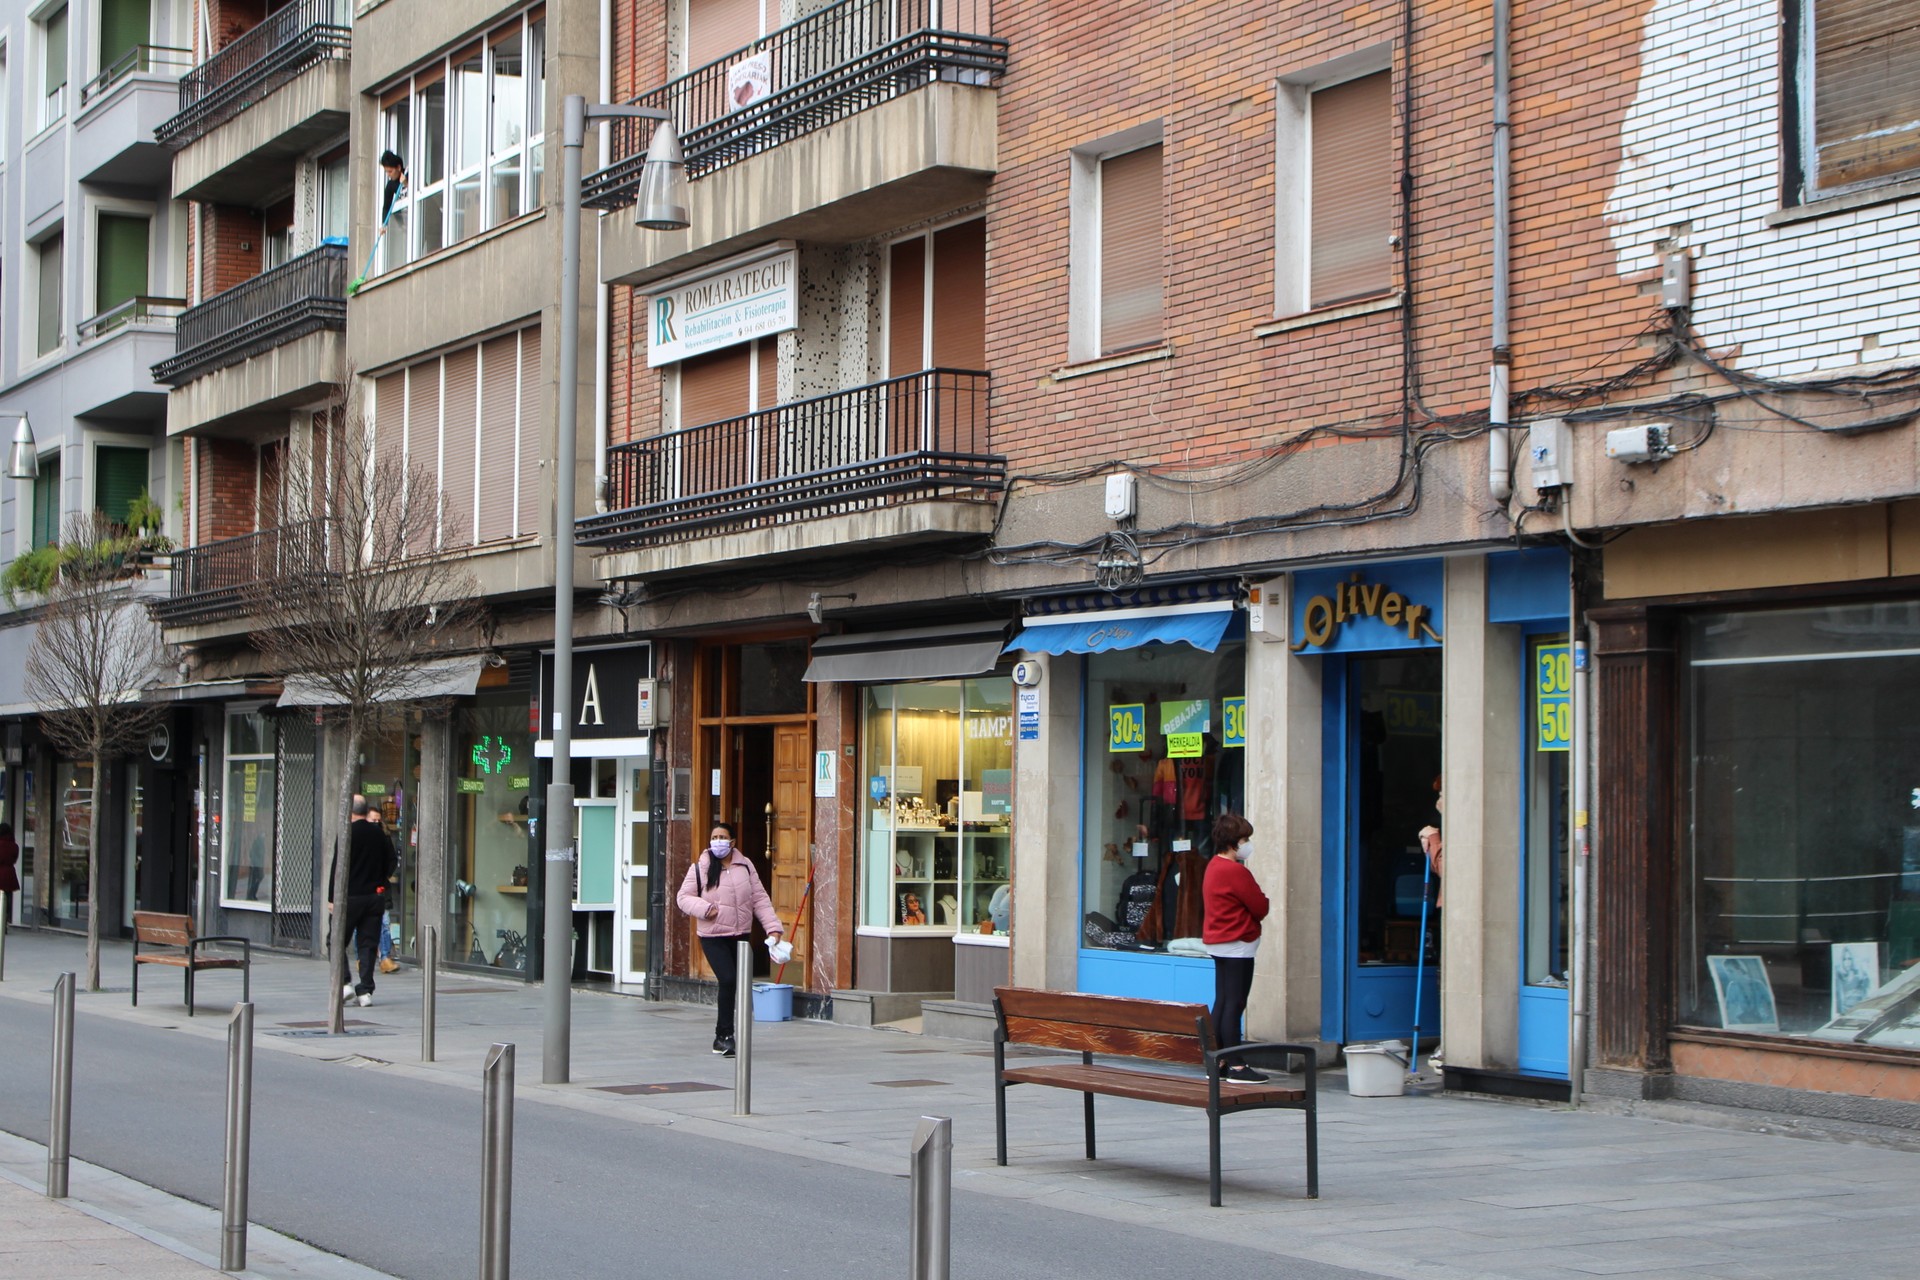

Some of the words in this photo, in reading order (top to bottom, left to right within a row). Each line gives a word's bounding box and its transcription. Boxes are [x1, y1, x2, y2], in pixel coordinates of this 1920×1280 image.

[685, 260, 786, 315] ROMARATEGUI
[684, 313, 732, 338] Rehabilitación
[734, 309, 741, 322] &
[1304, 572, 1428, 648] Oliver
[1540, 653, 1570, 693] 30
[578, 663, 604, 725] A
[1021, 694, 1036, 703] tyco
[1112, 711, 1143, 744] 30%
[1164, 700, 1203, 735] REBAJAS
[1542, 703, 1570, 742] 50
